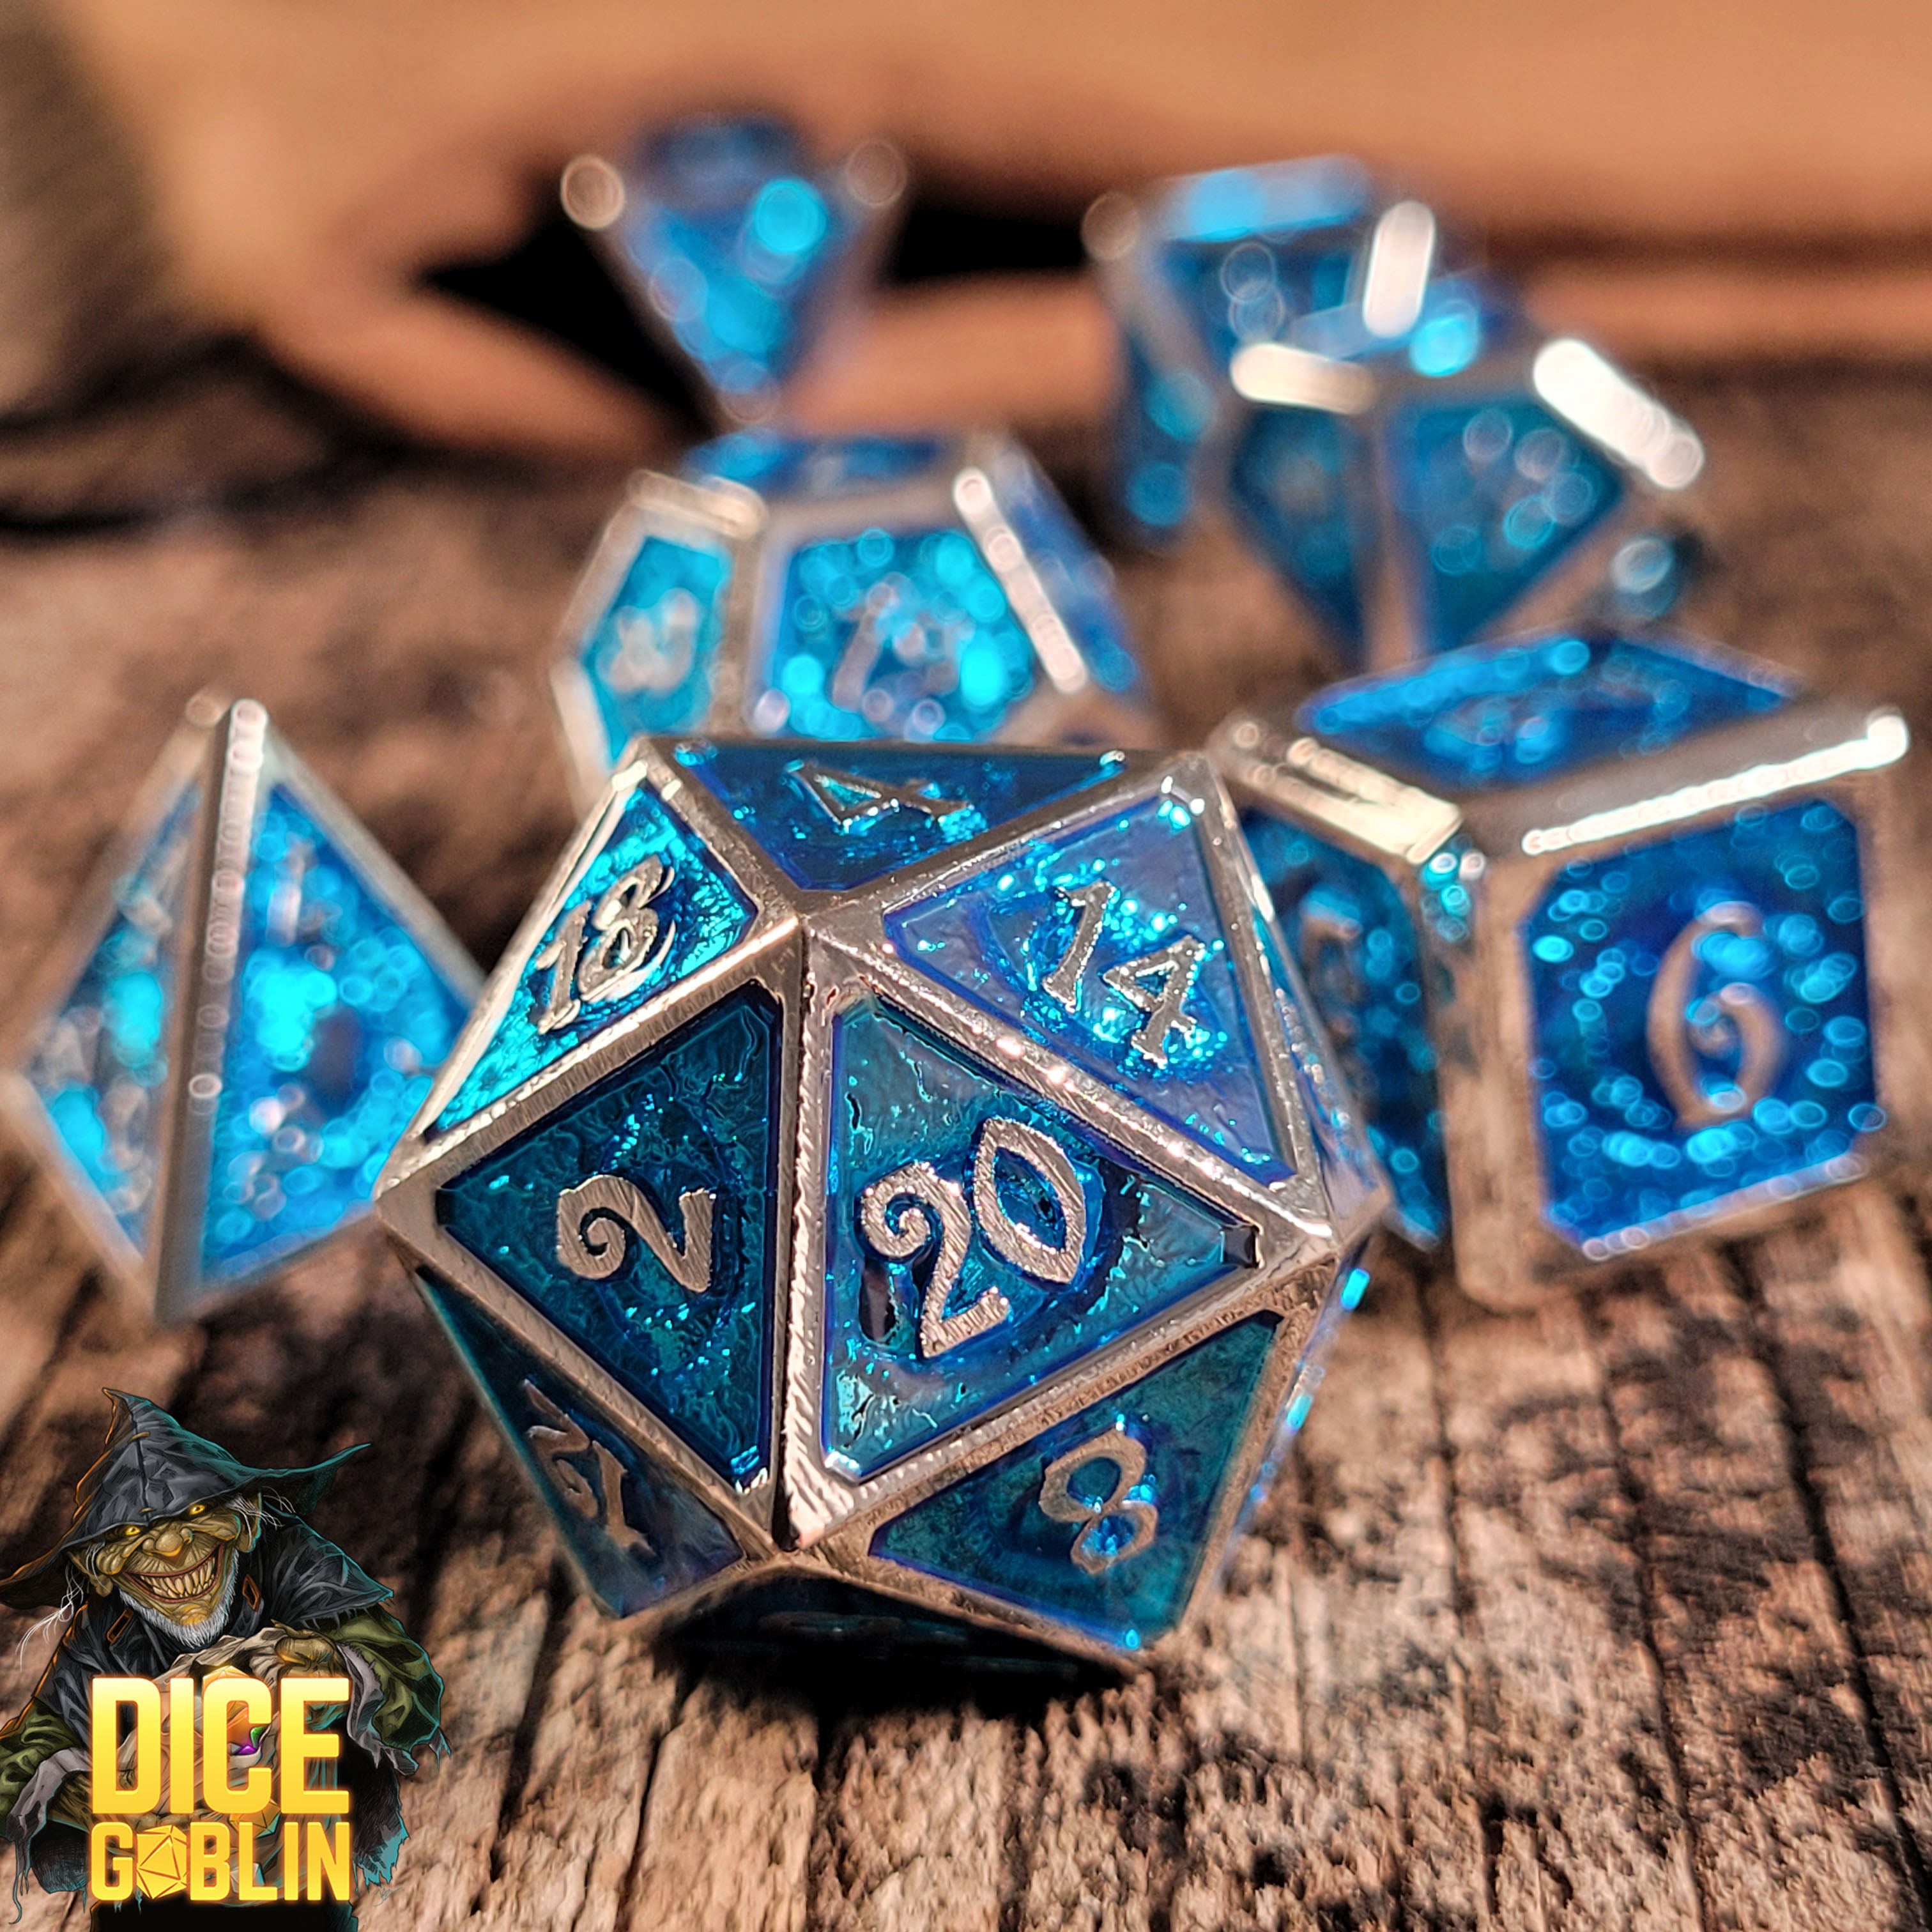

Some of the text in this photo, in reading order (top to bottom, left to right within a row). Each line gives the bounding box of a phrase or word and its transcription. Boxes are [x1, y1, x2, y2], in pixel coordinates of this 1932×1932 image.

[535, 855, 672, 1035] 18
[1042, 878, 1206, 1070] 14
[1647, 901, 1787, 1133] 6
[556, 1174, 716, 1292] 2
[861, 1117, 1086, 1358] 20
[1039, 1429, 1158, 1575] 8
